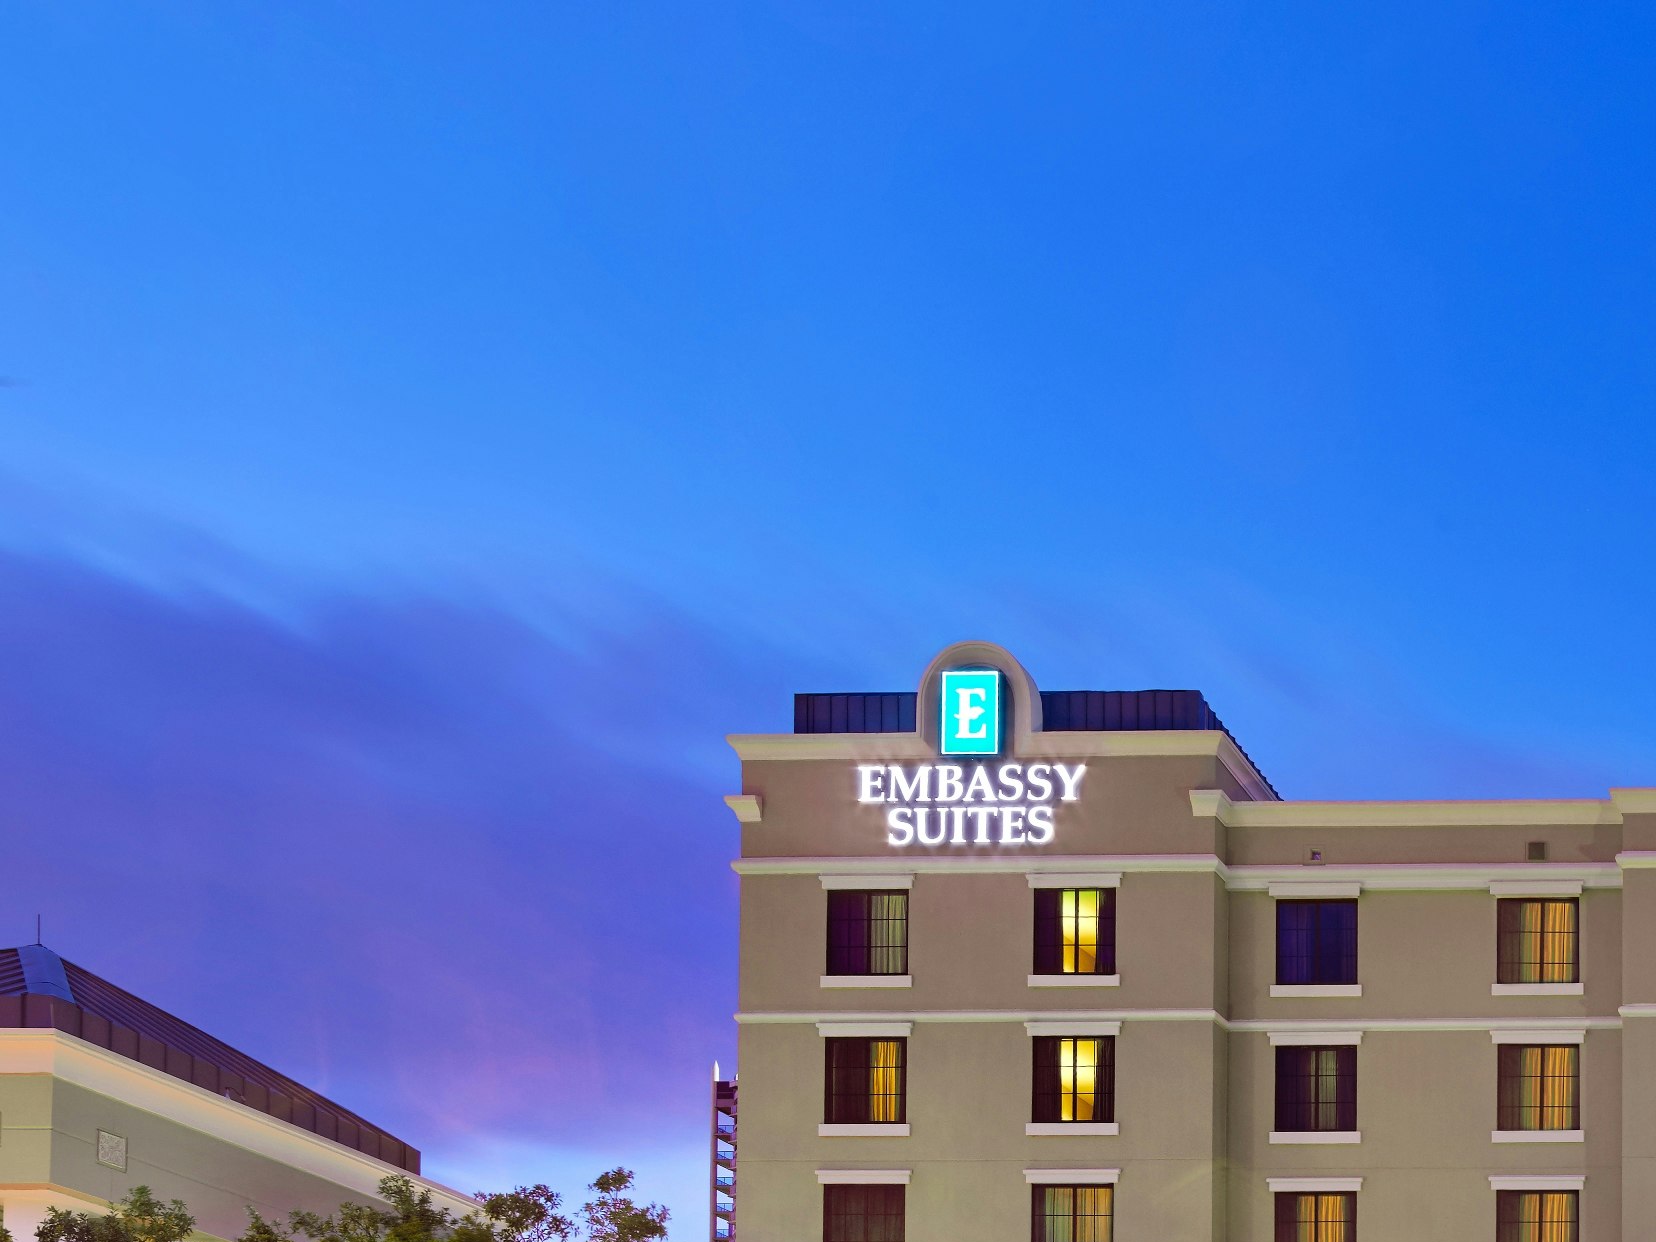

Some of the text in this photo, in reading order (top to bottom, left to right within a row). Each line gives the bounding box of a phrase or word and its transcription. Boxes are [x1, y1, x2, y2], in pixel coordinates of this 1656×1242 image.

[954, 687, 987, 739] E
[857, 764, 1087, 802] EMBASSY
[887, 805, 1054, 845] SUITES
